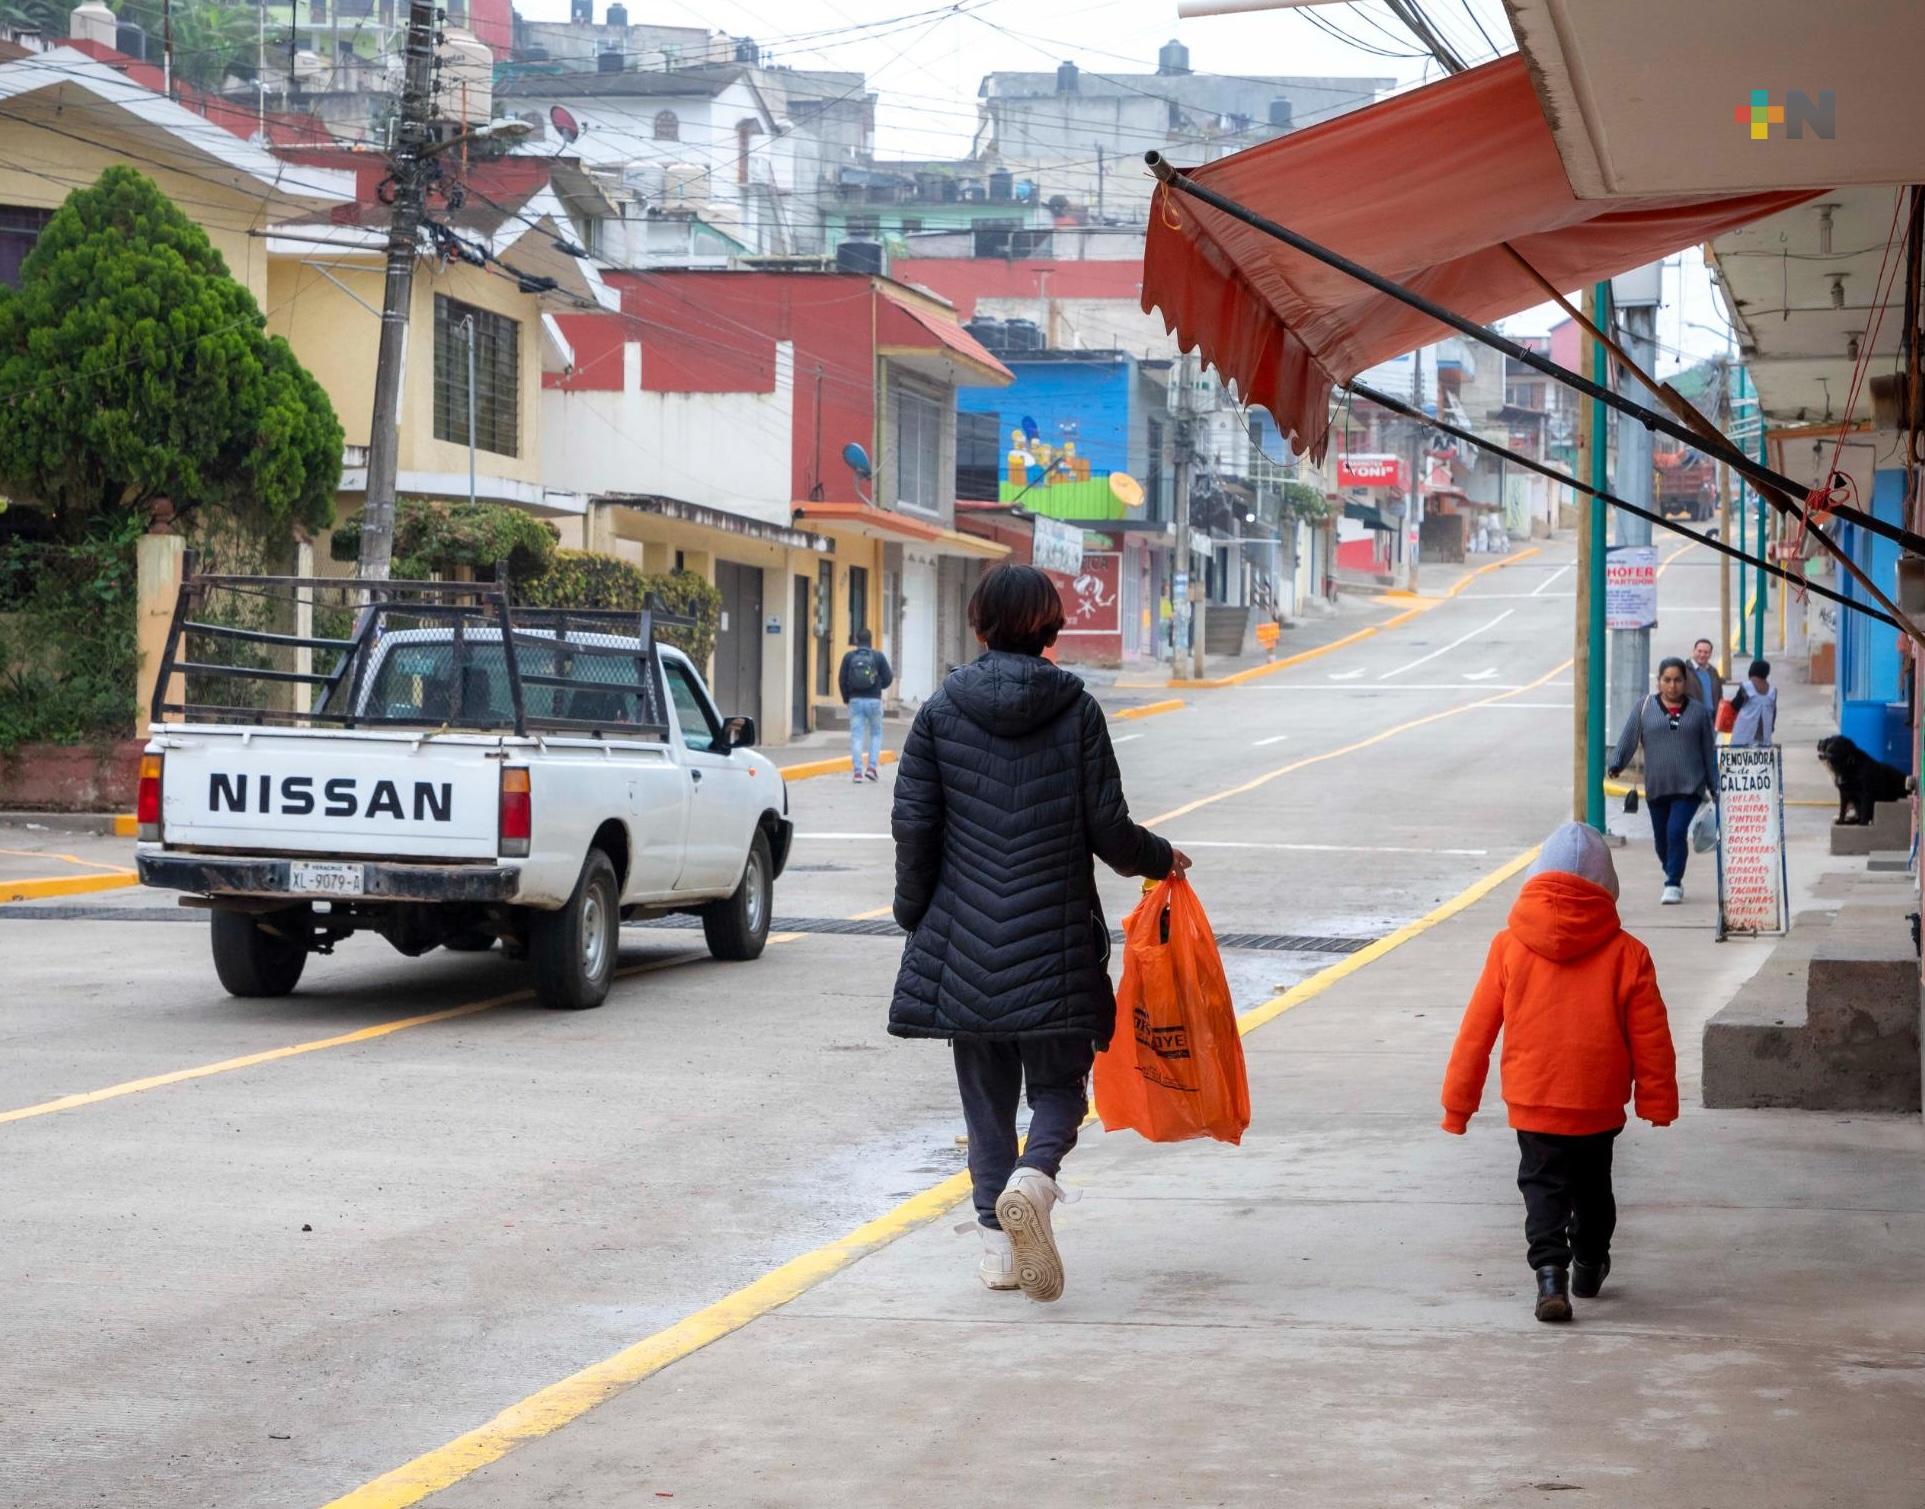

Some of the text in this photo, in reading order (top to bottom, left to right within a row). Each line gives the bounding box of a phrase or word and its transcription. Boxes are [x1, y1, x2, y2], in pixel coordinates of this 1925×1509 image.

[1606, 567, 1653, 576] HOFER
[1719, 750, 1775, 768] RENOVADORA
[1720, 775, 1771, 792] CALZADO
[209, 773, 453, 821] NISSAN
[1728, 815, 1768, 824] PINTURA
[293, 872, 360, 890] XL-9079-A
